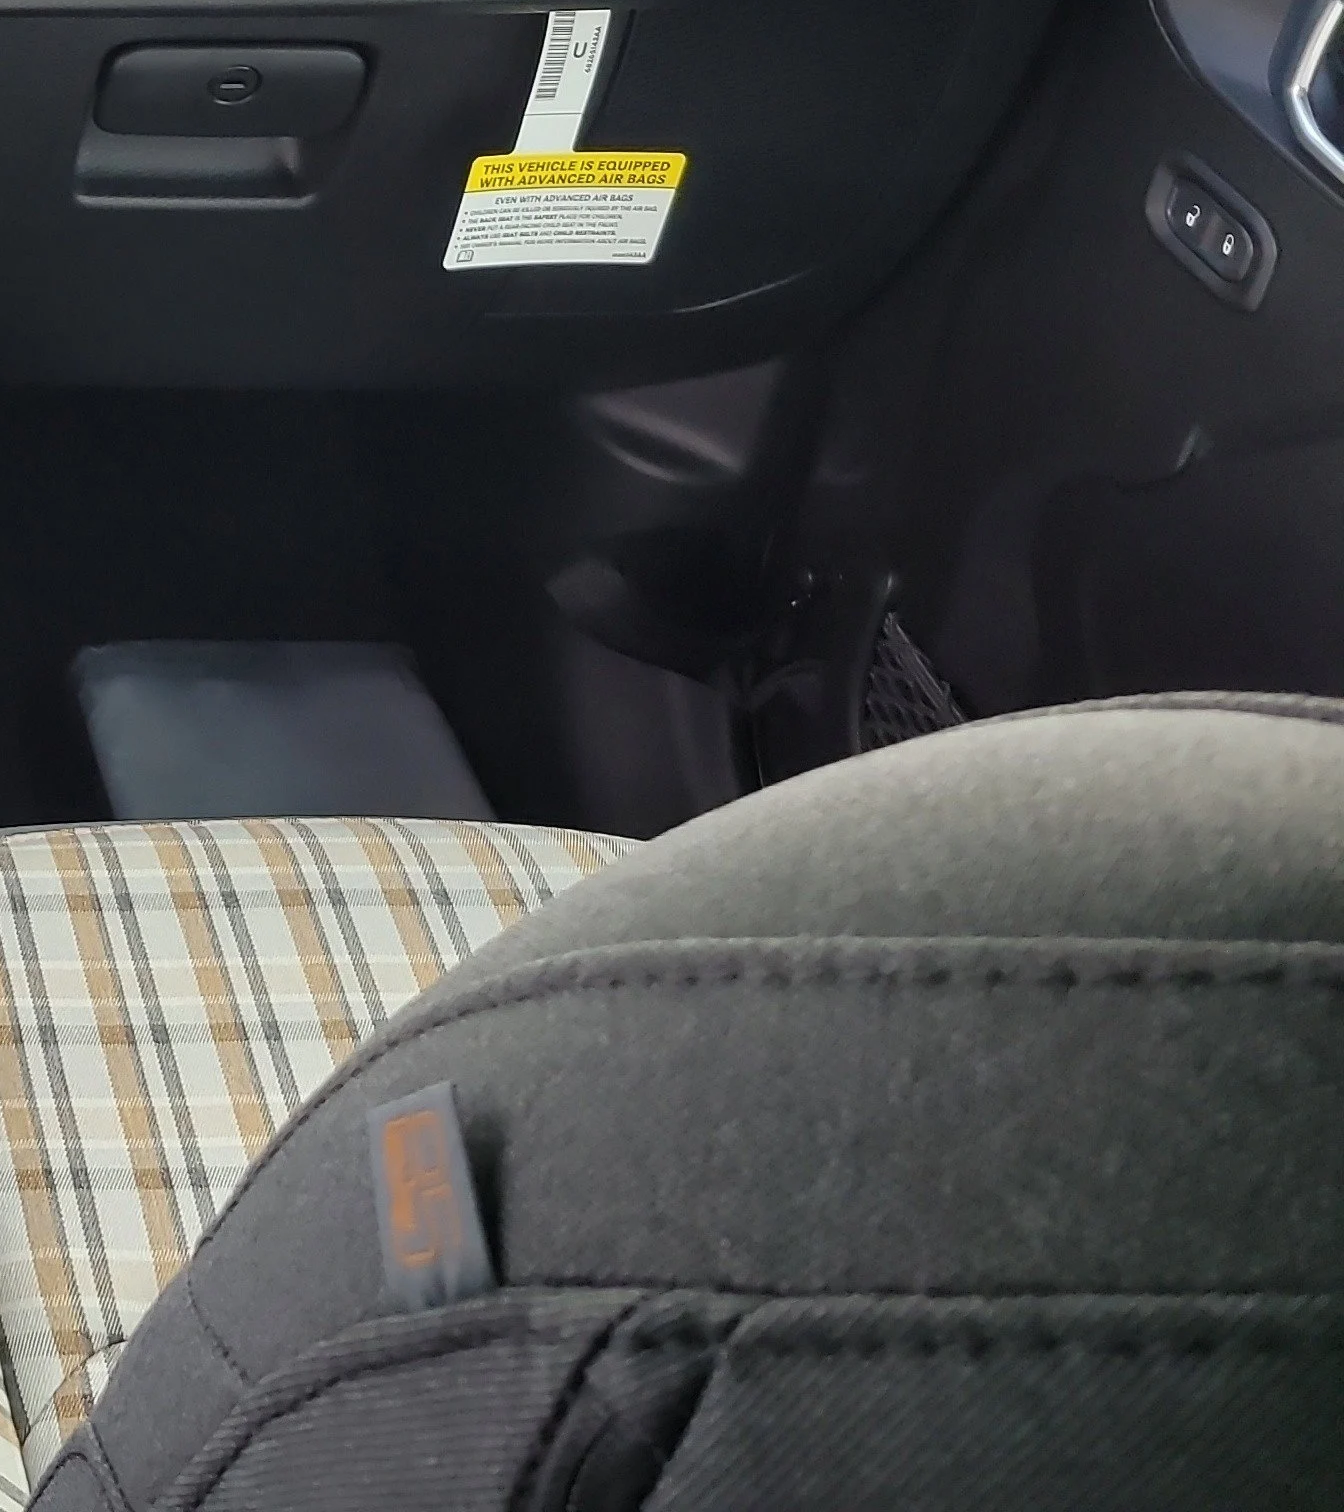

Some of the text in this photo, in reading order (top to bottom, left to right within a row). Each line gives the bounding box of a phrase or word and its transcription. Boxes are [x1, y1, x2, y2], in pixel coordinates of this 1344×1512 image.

[573, 41, 588, 59] U
[483, 160, 671, 175] THIS VEHICLE IS EQUIPPED
[480, 174, 667, 188] WITH ADVANCED AIR BAGS
[495, 194, 634, 205] EVEN WITH ADVANCED AIR BAGS
